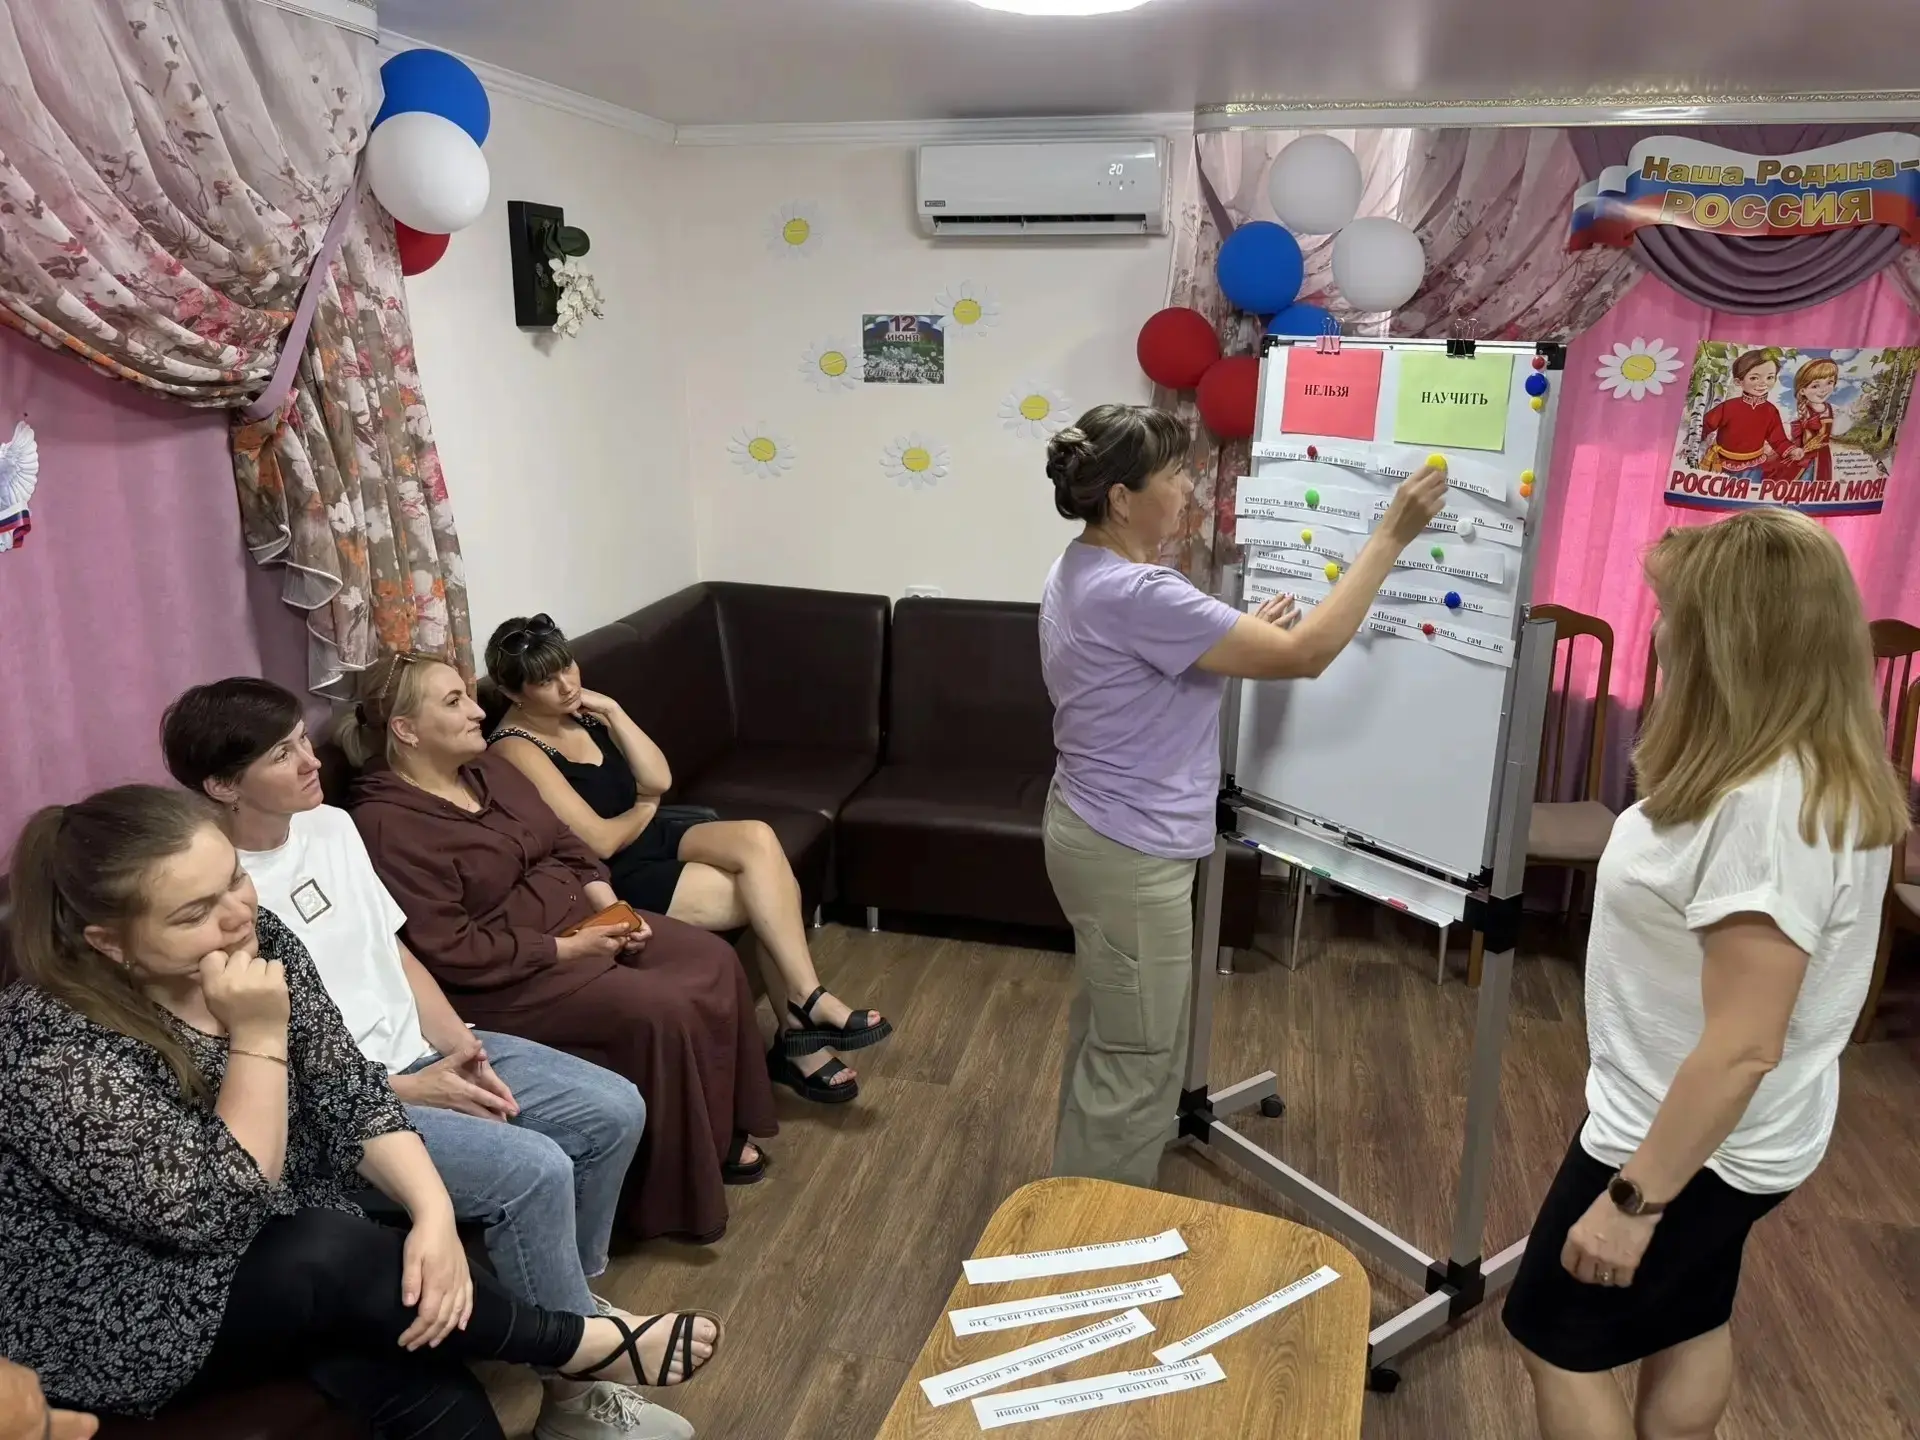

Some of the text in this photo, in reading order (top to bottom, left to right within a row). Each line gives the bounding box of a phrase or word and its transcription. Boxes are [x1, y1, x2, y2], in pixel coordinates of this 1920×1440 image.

[1108, 163, 1124, 175] 20
[1640, 155, 1745, 186] Наша
[1659, 188, 1874, 228] РОССИЯ
[889, 315, 917, 332] 12
[1304, 384, 1349, 398] НЕЛЬЗЯ
[1421, 391, 1488, 406] НАУЧИТЬ
[1843, 478, 1886, 501] МОЯ!
[1435, 564, 1489, 579] остановиться
[1398, 591, 1427, 602] говори
[1369, 621, 1397, 634] трогай
[1372, 610, 1407, 625] «Позови
[1466, 636, 1482, 646] сам
[1092, 1294, 1135, 1308] должен
[1136, 1288, 1162, 1299] «Ты
[1023, 1299, 1090, 1317] рассказать
[968, 1317, 993, 1327] Это
[1004, 1365, 1020, 1374] не
[945, 1371, 1002, 1398] наступай
[994, 1370, 1208, 1419] «Не подходи близко, позови
